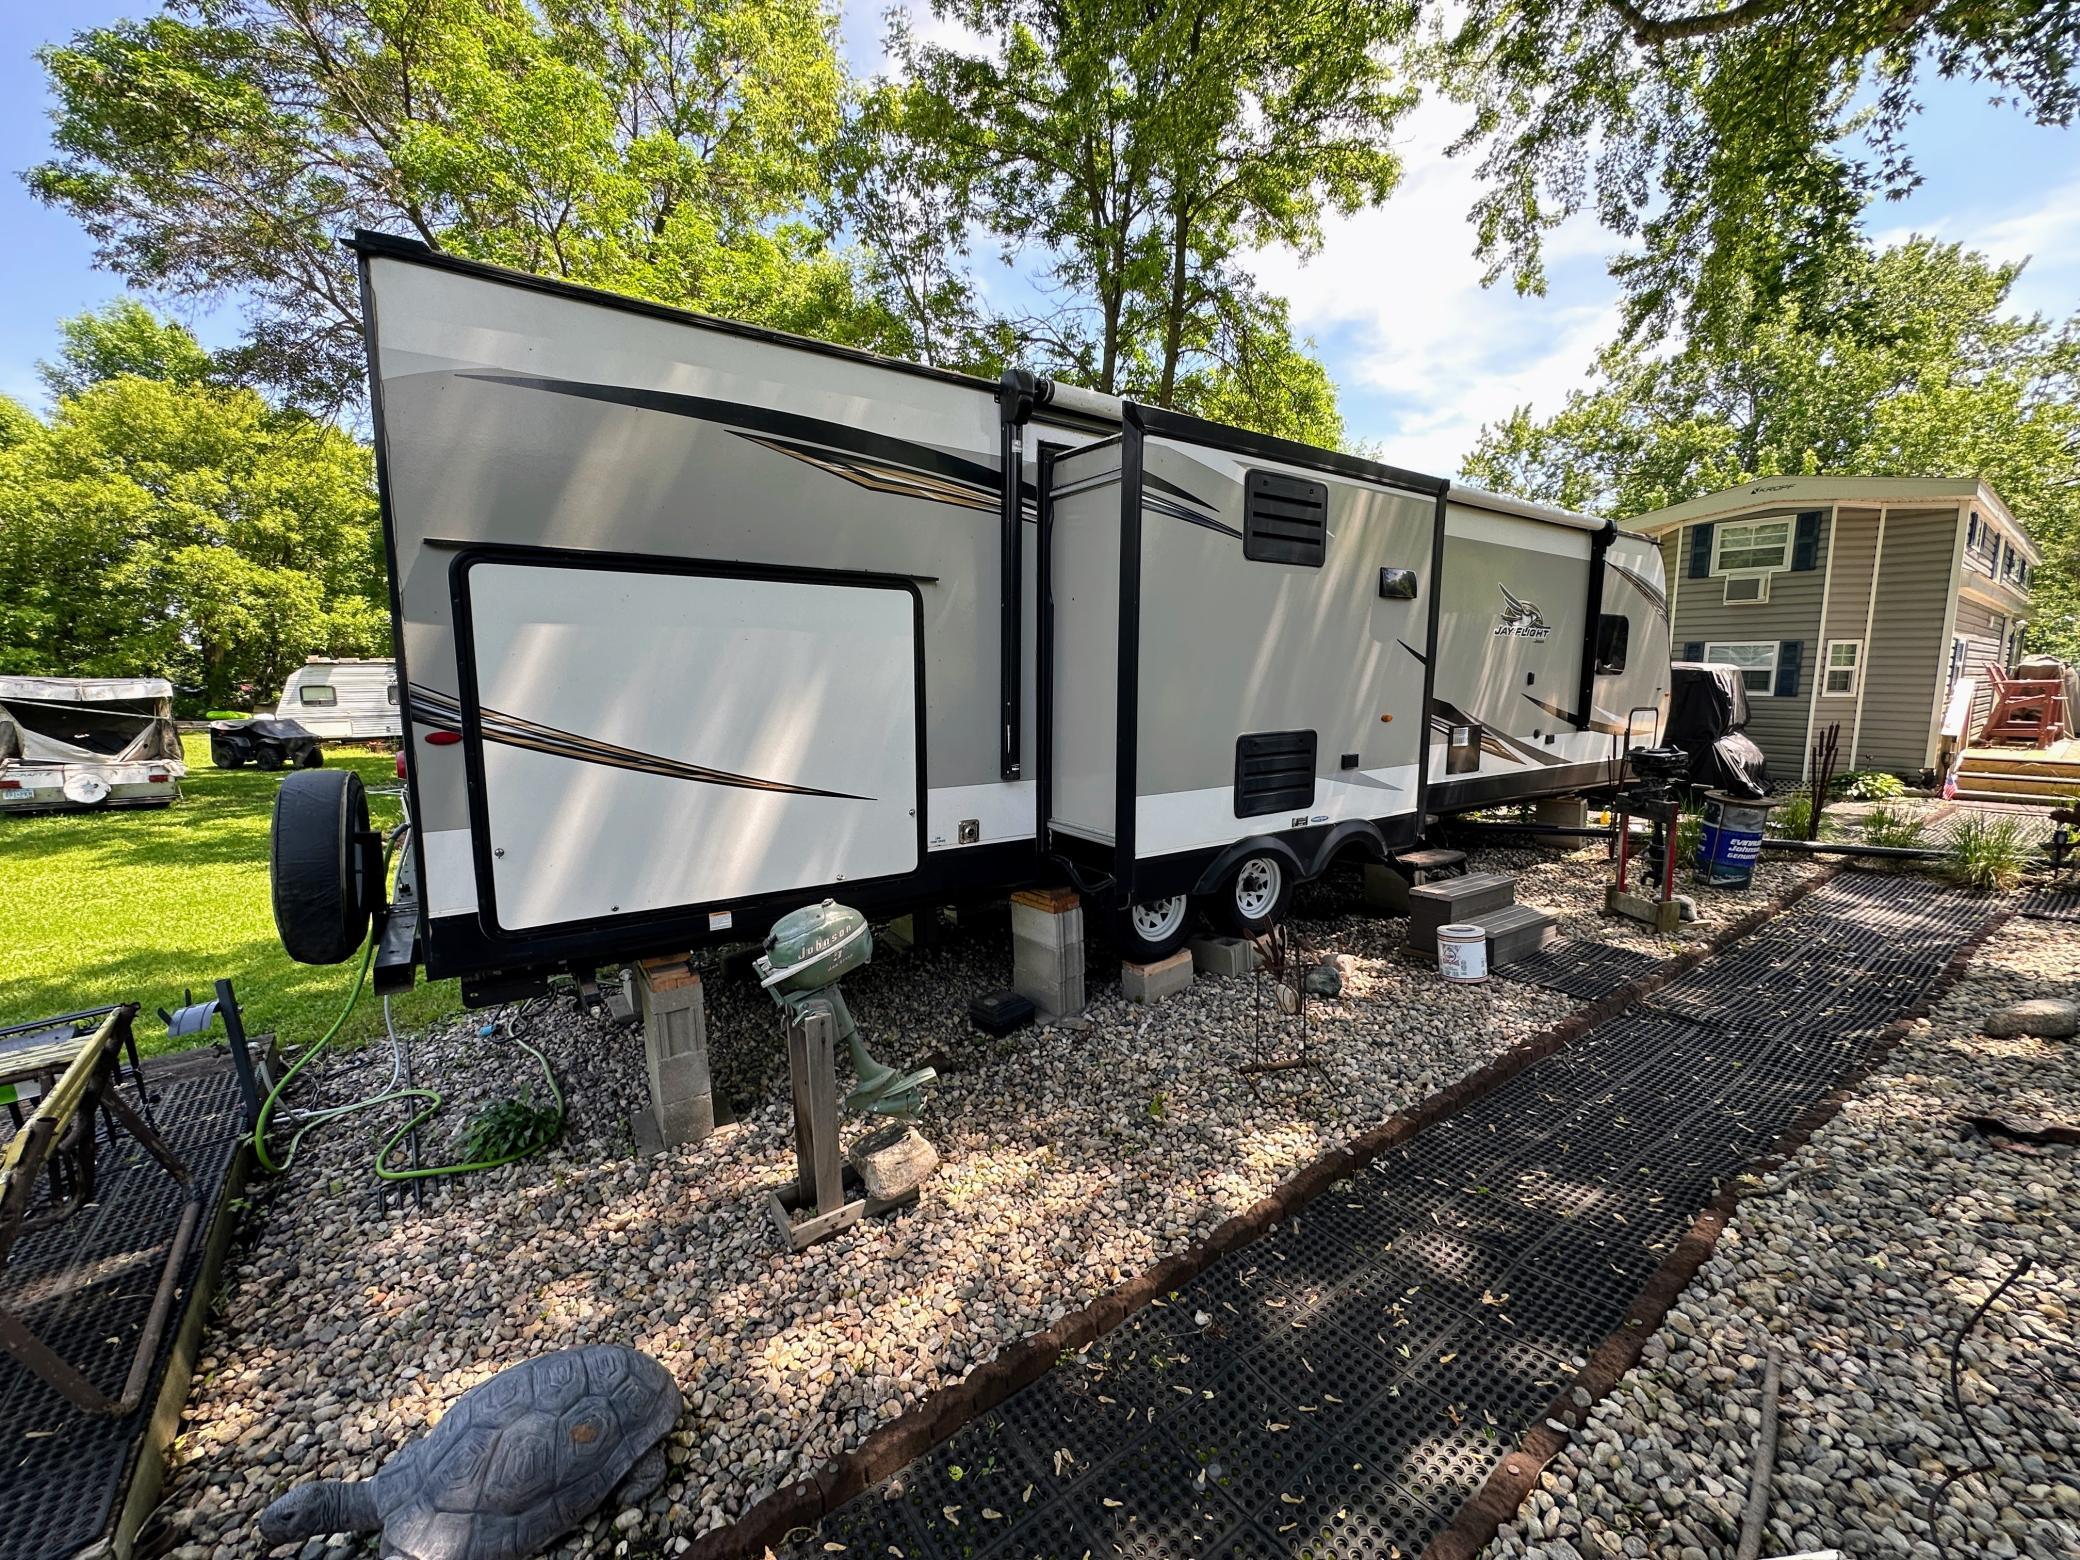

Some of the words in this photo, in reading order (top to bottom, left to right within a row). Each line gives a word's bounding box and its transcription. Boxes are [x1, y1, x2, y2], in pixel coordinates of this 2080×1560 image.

[1494, 625, 1514, 636] JAY
[1515, 627, 1549, 638] FLIGHT
[798, 924, 852, 960] Johnson
